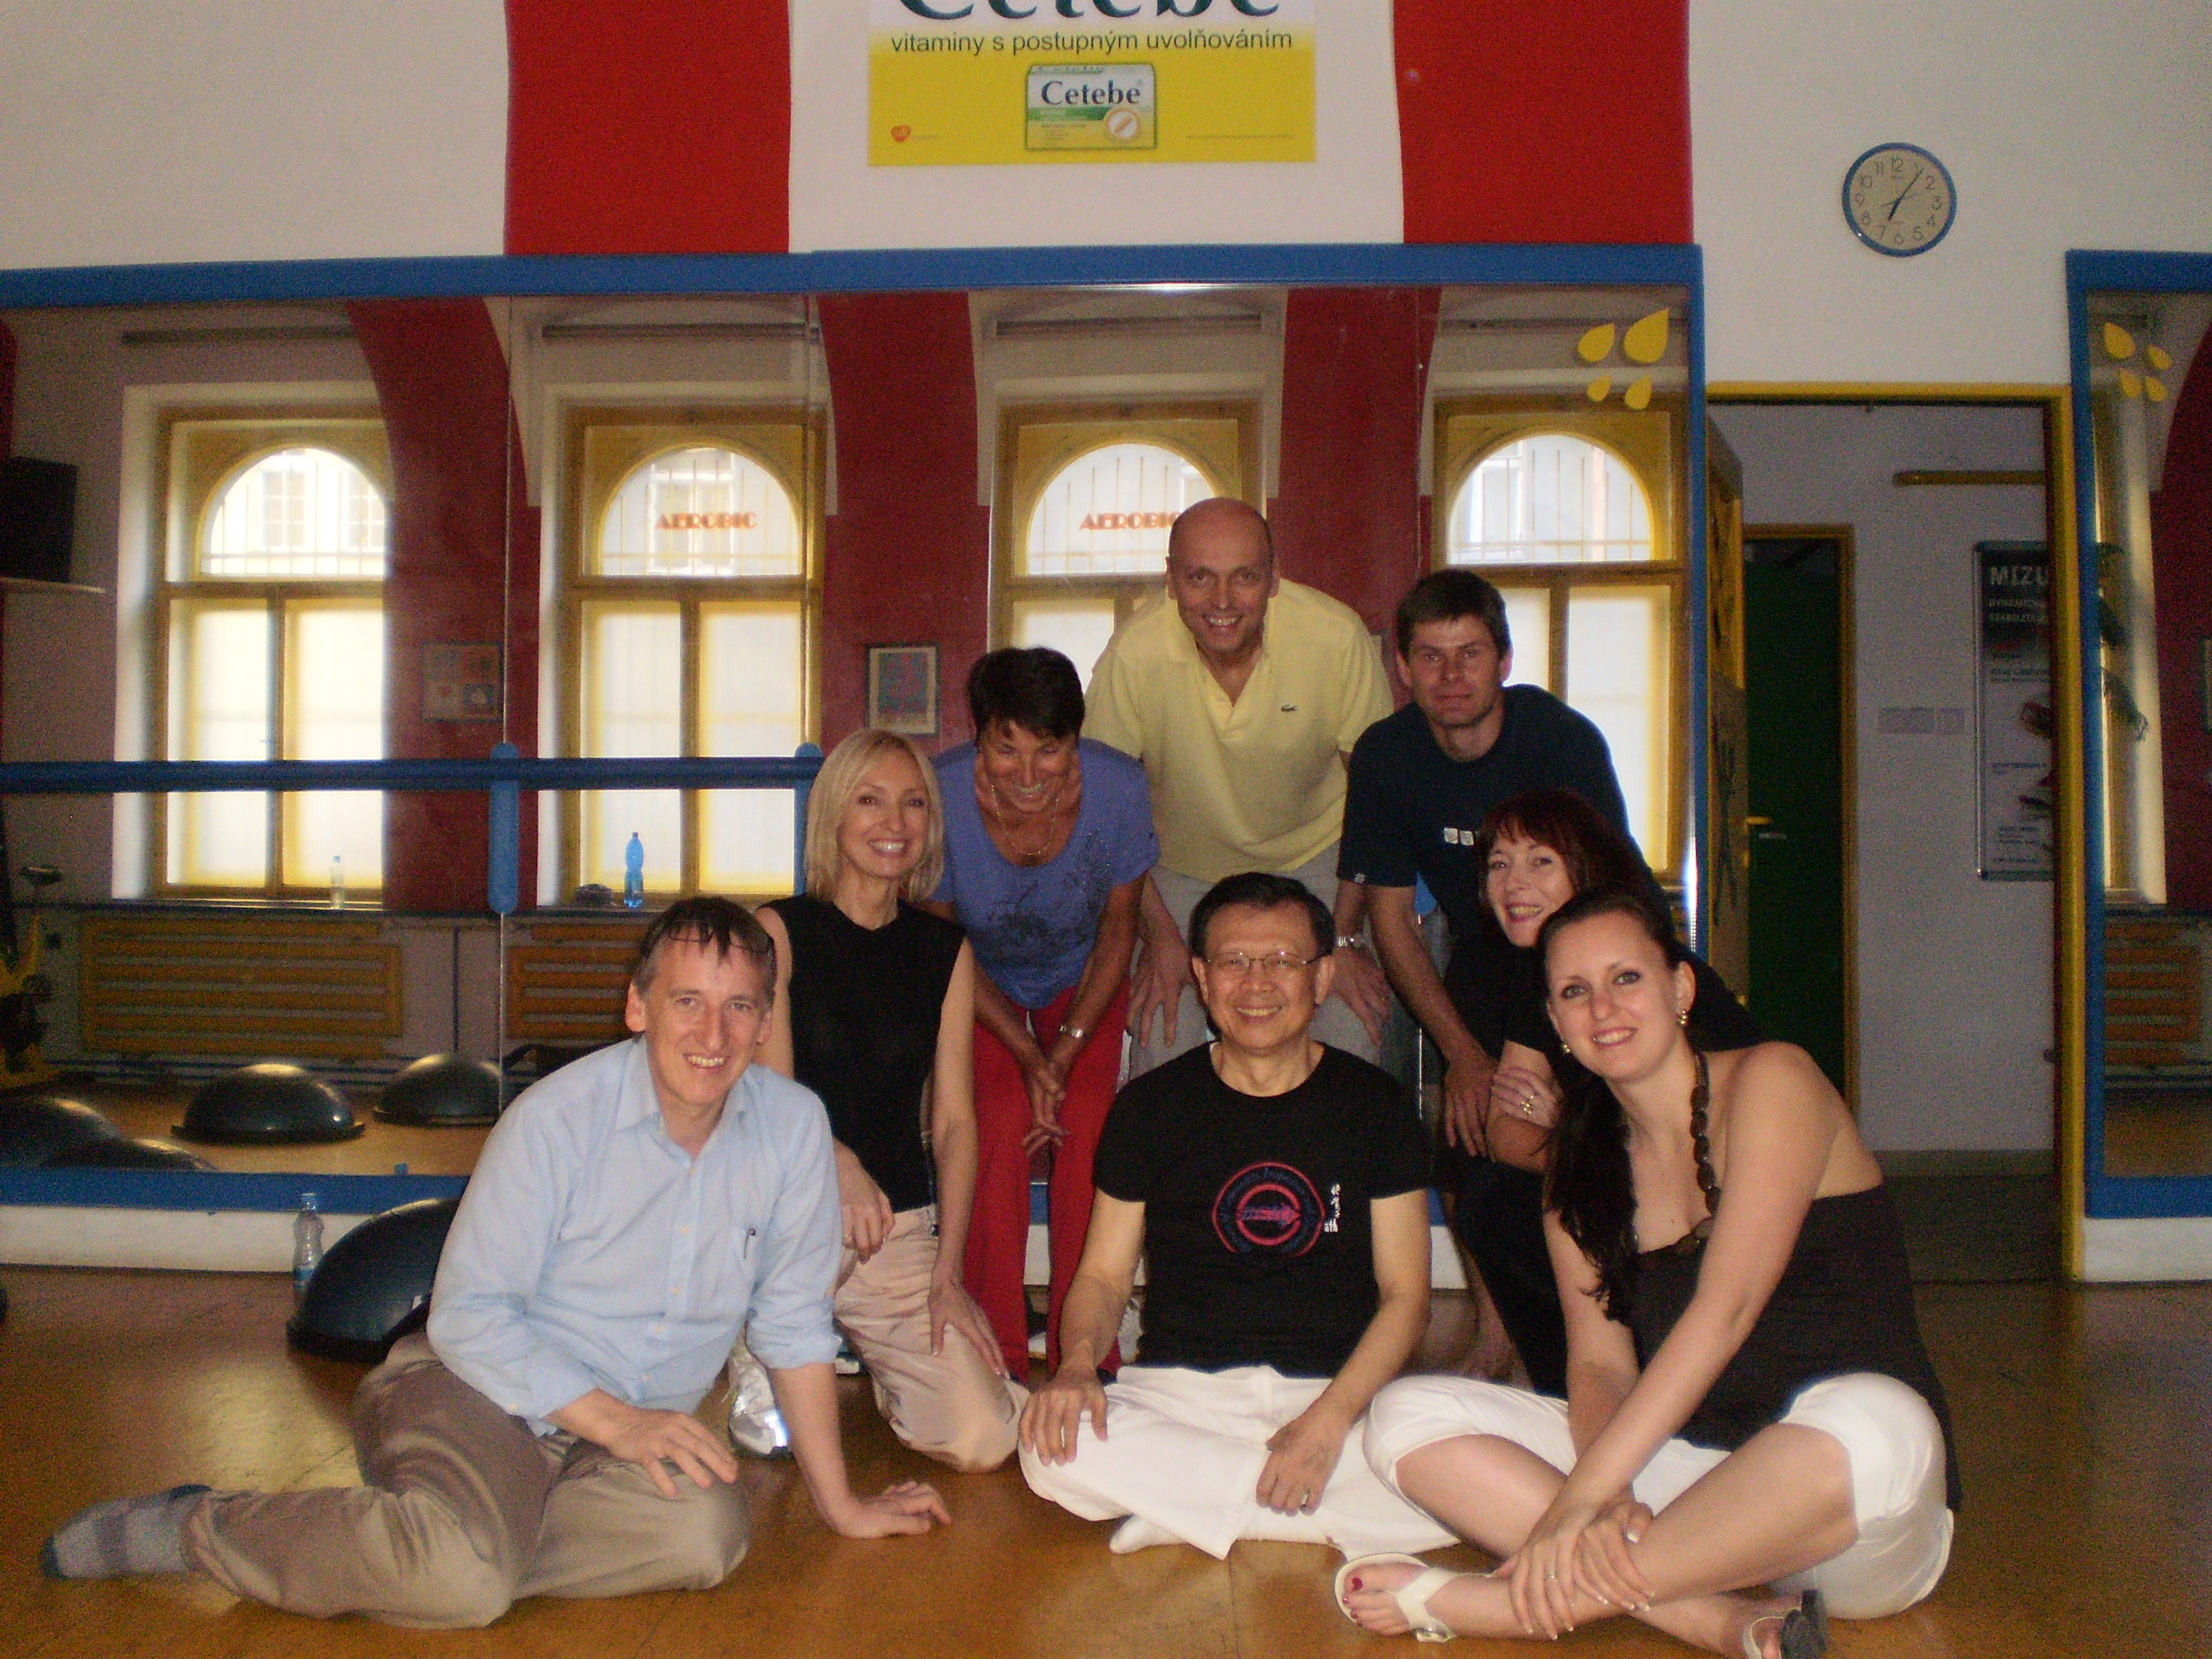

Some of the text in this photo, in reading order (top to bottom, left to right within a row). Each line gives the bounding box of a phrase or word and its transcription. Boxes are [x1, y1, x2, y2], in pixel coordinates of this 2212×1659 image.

[891, 28, 1292, 56] vitaminy s postupným uvolňováním
[1041, 79, 1141, 105] Cetebe
[1875, 161, 1884, 176] 11
[1890, 157, 1904, 172] 12
[1860, 174, 1872, 189] 10
[1925, 175, 1936, 190] 2
[1855, 192, 1864, 207] 9
[1931, 195, 1942, 210] 3
[1877, 225, 1886, 239] 7
[1913, 226, 1923, 241] 5
[655, 511, 758, 531] AEROBIC
